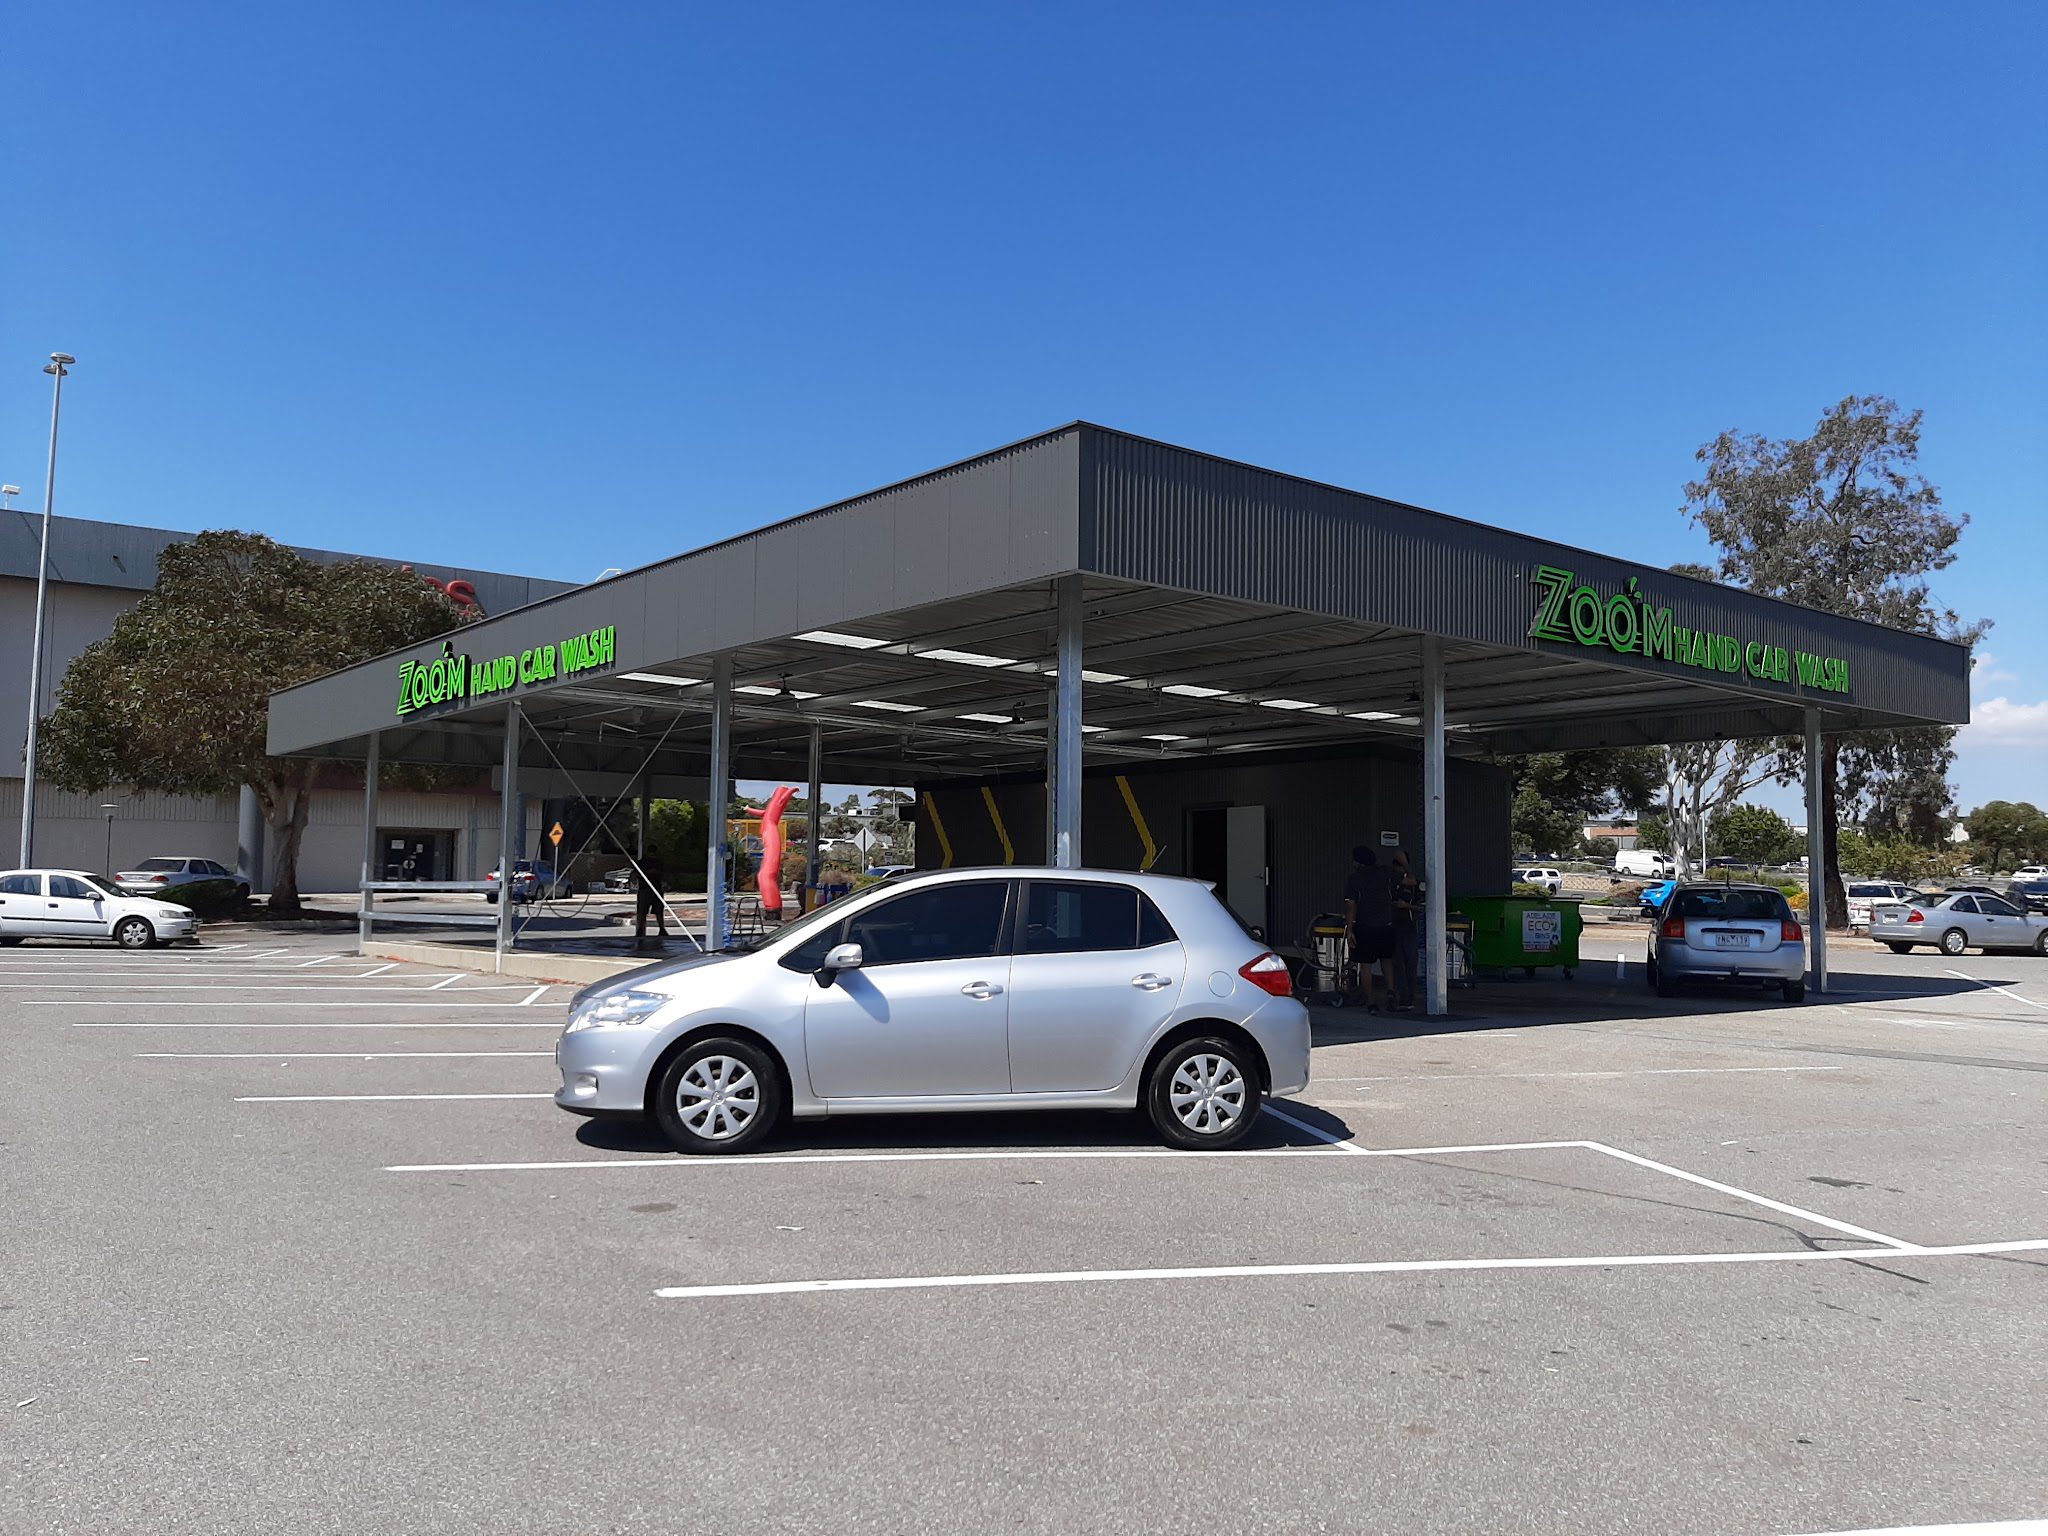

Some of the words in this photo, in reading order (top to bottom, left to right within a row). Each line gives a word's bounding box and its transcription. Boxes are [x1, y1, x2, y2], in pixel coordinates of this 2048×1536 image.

[469, 656, 516, 697] HAND
[519, 645, 557, 684] CAR
[560, 624, 615, 674] WASH
[1673, 625, 1741, 674] HAND
[1745, 640, 1790, 683] CAR
[1794, 650, 1849, 694] WASH
[1528, 920, 1551, 931] ECO
